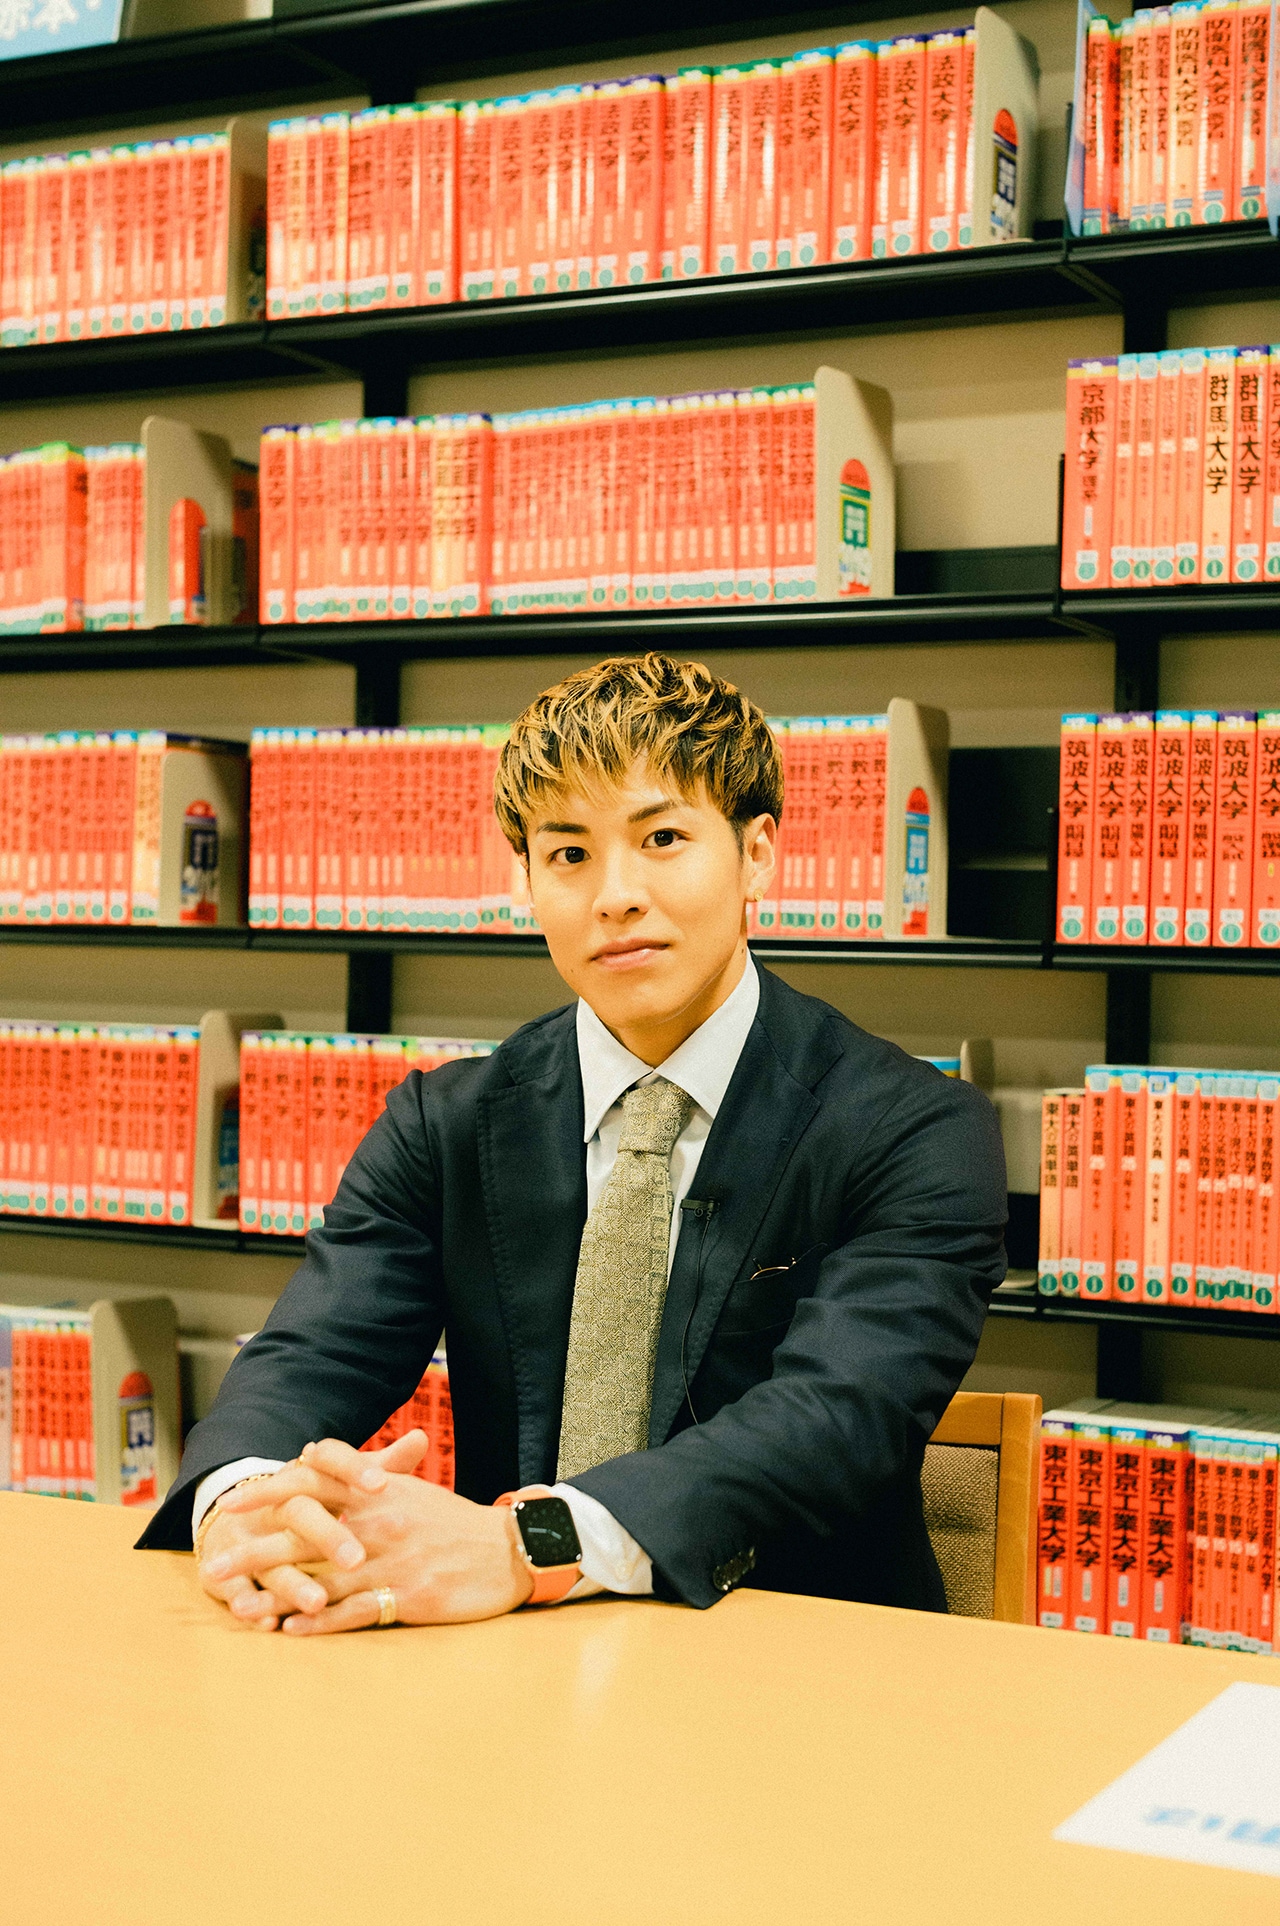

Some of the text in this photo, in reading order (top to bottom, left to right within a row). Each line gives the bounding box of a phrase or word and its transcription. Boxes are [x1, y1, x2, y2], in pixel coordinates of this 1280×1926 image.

[1081, 383, 1106, 470] 京都大学
[1207, 375, 1228, 494] 群馬大学
[1238, 375, 1261, 494] 群馬大学
[1064, 740, 1089, 818] 筑波大学
[1099, 740, 1126, 819] 筑波大学
[1130, 738, 1149, 817] 筑波大学
[1157, 738, 1184, 817] 筑波大学
[1192, 738, 1211, 817] 筑波大学
[1220, 739, 1250, 819] 筑波大学
[1041, 1444, 1068, 1563] 東京工業大学
[1075, 1449, 1102, 1568] 東京工業大学
[1112, 1453, 1140, 1572] 東京工業大学
[1147, 1457, 1176, 1578] 東京工業大学
